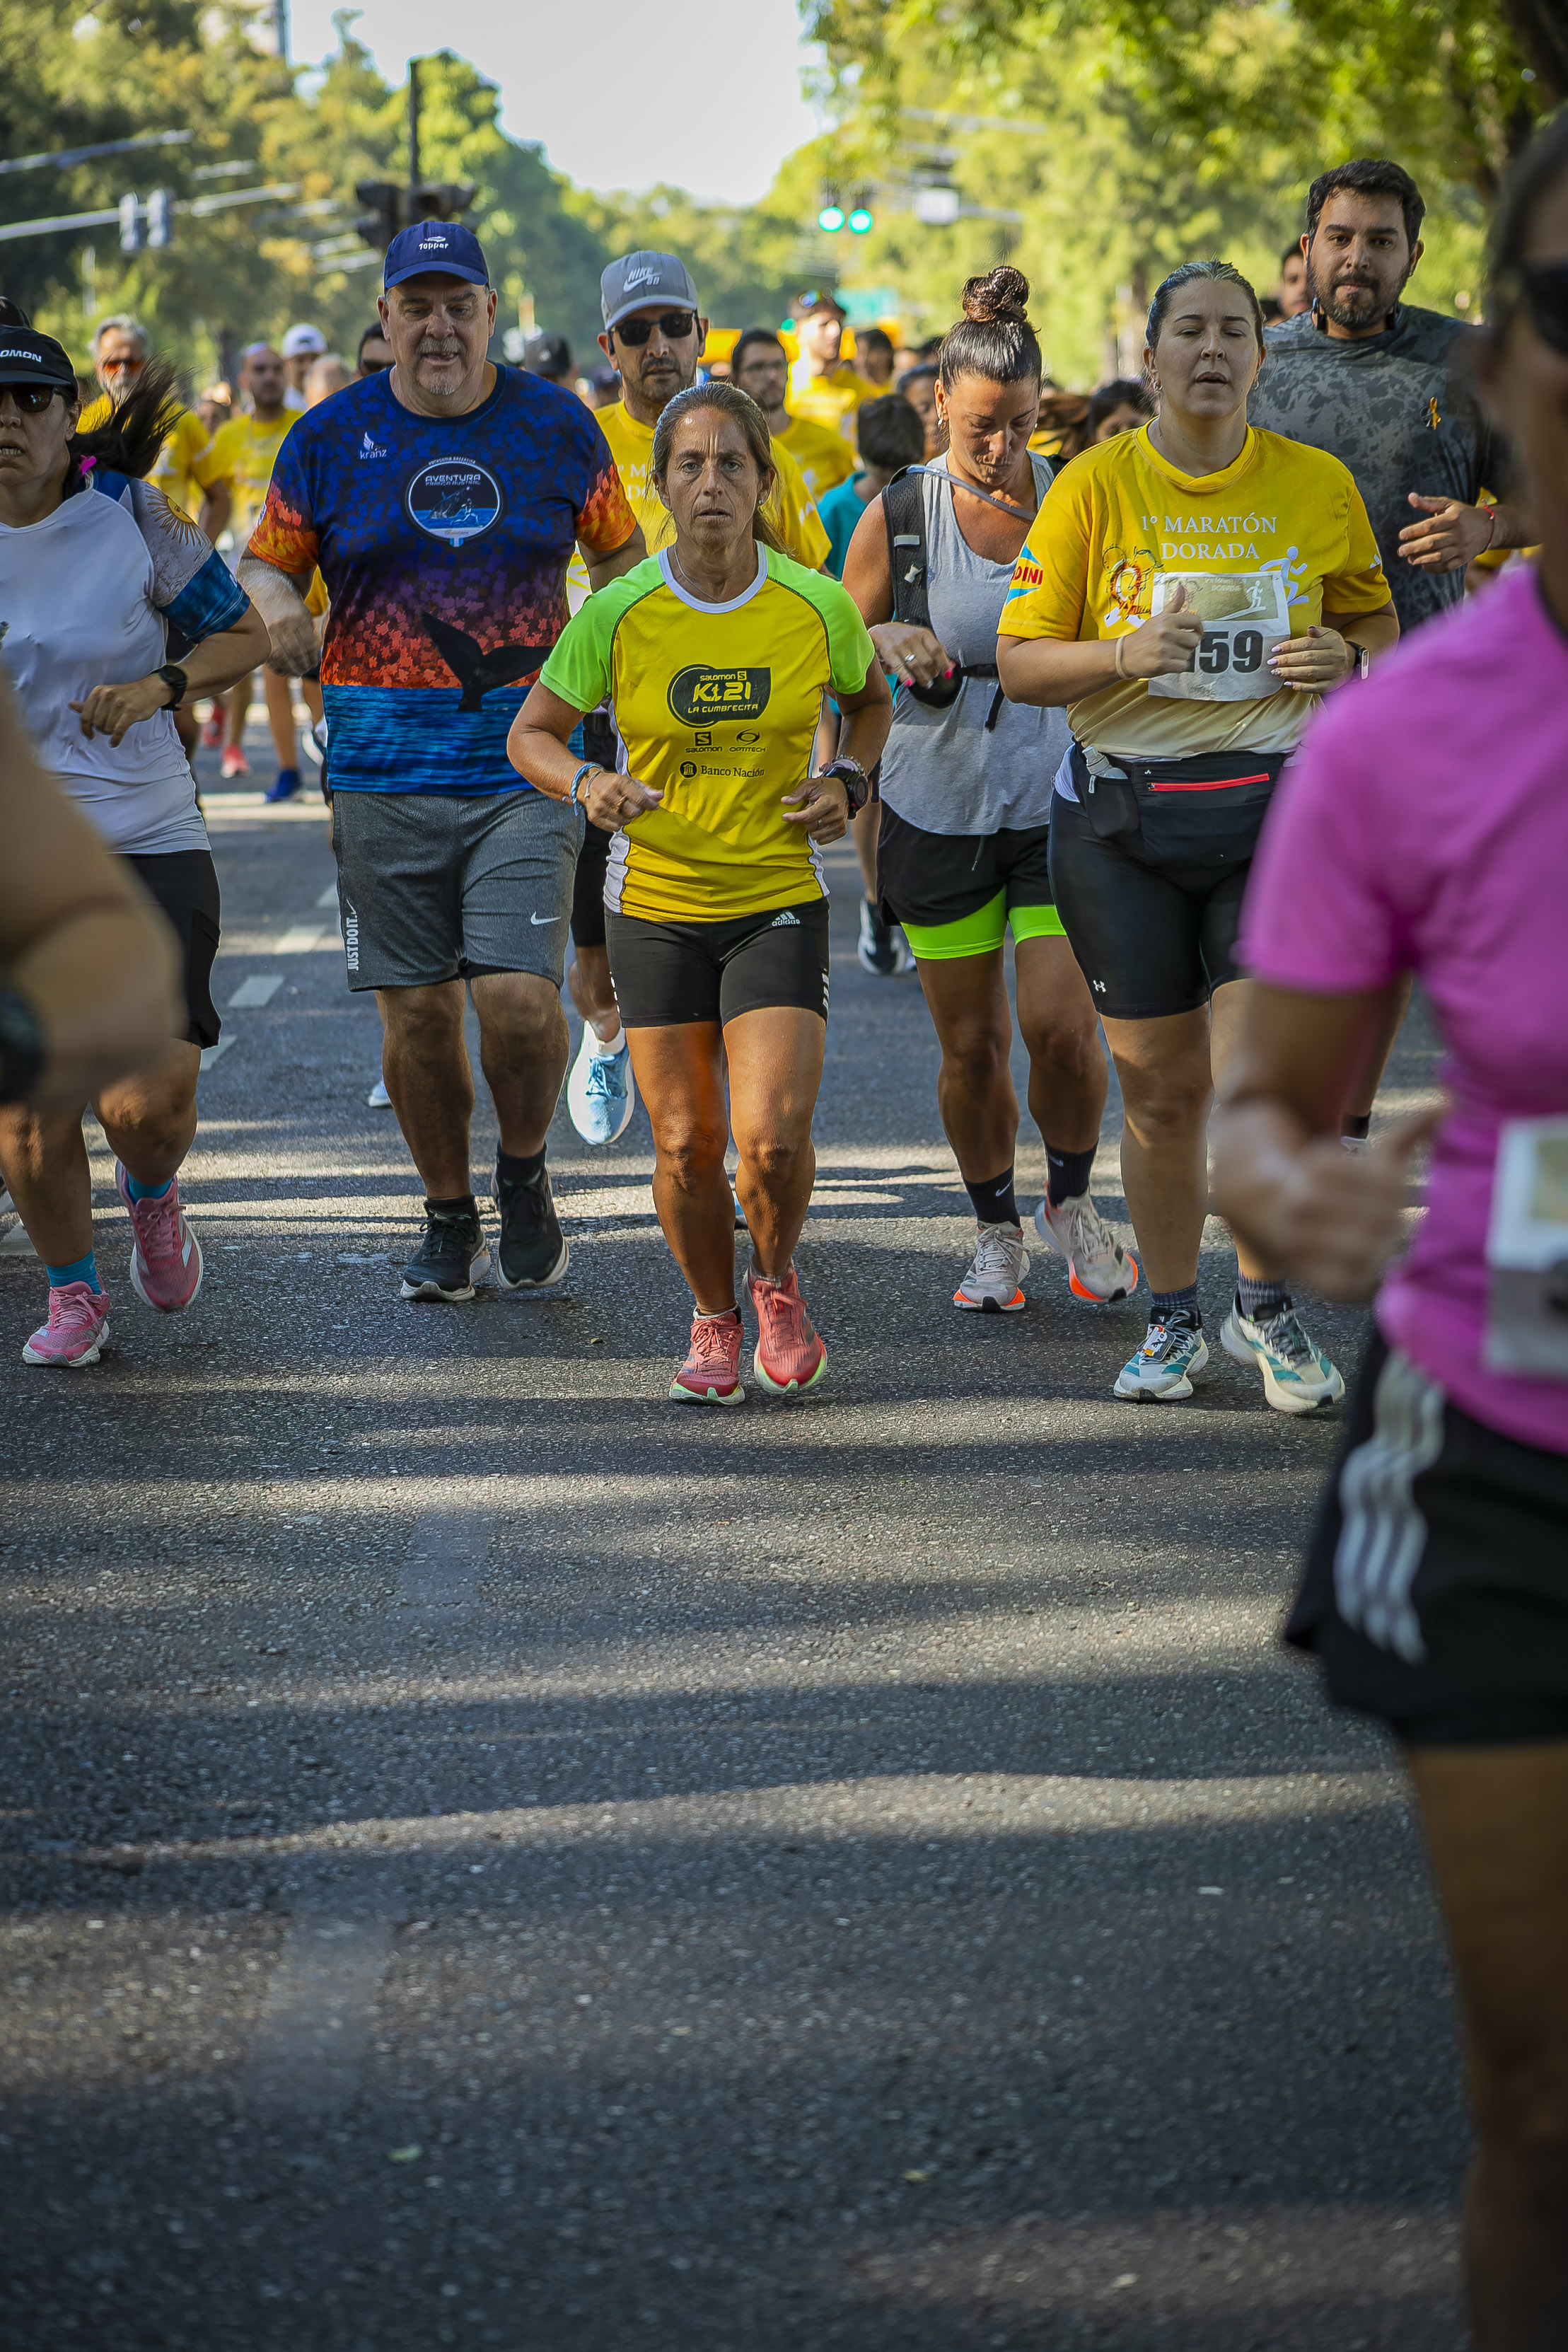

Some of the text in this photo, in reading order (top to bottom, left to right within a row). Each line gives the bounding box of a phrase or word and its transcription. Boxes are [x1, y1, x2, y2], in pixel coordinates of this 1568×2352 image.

[425, 474, 481, 482] AVENTURA
[1164, 512, 1277, 533] MARATÓN
[1161, 543, 1260, 560] DORADA
[1183, 630, 1264, 674] 59
[700, 765, 765, 777] Banco Nación
[347, 928, 359, 945] DO
[347, 946, 359, 971] JUST
